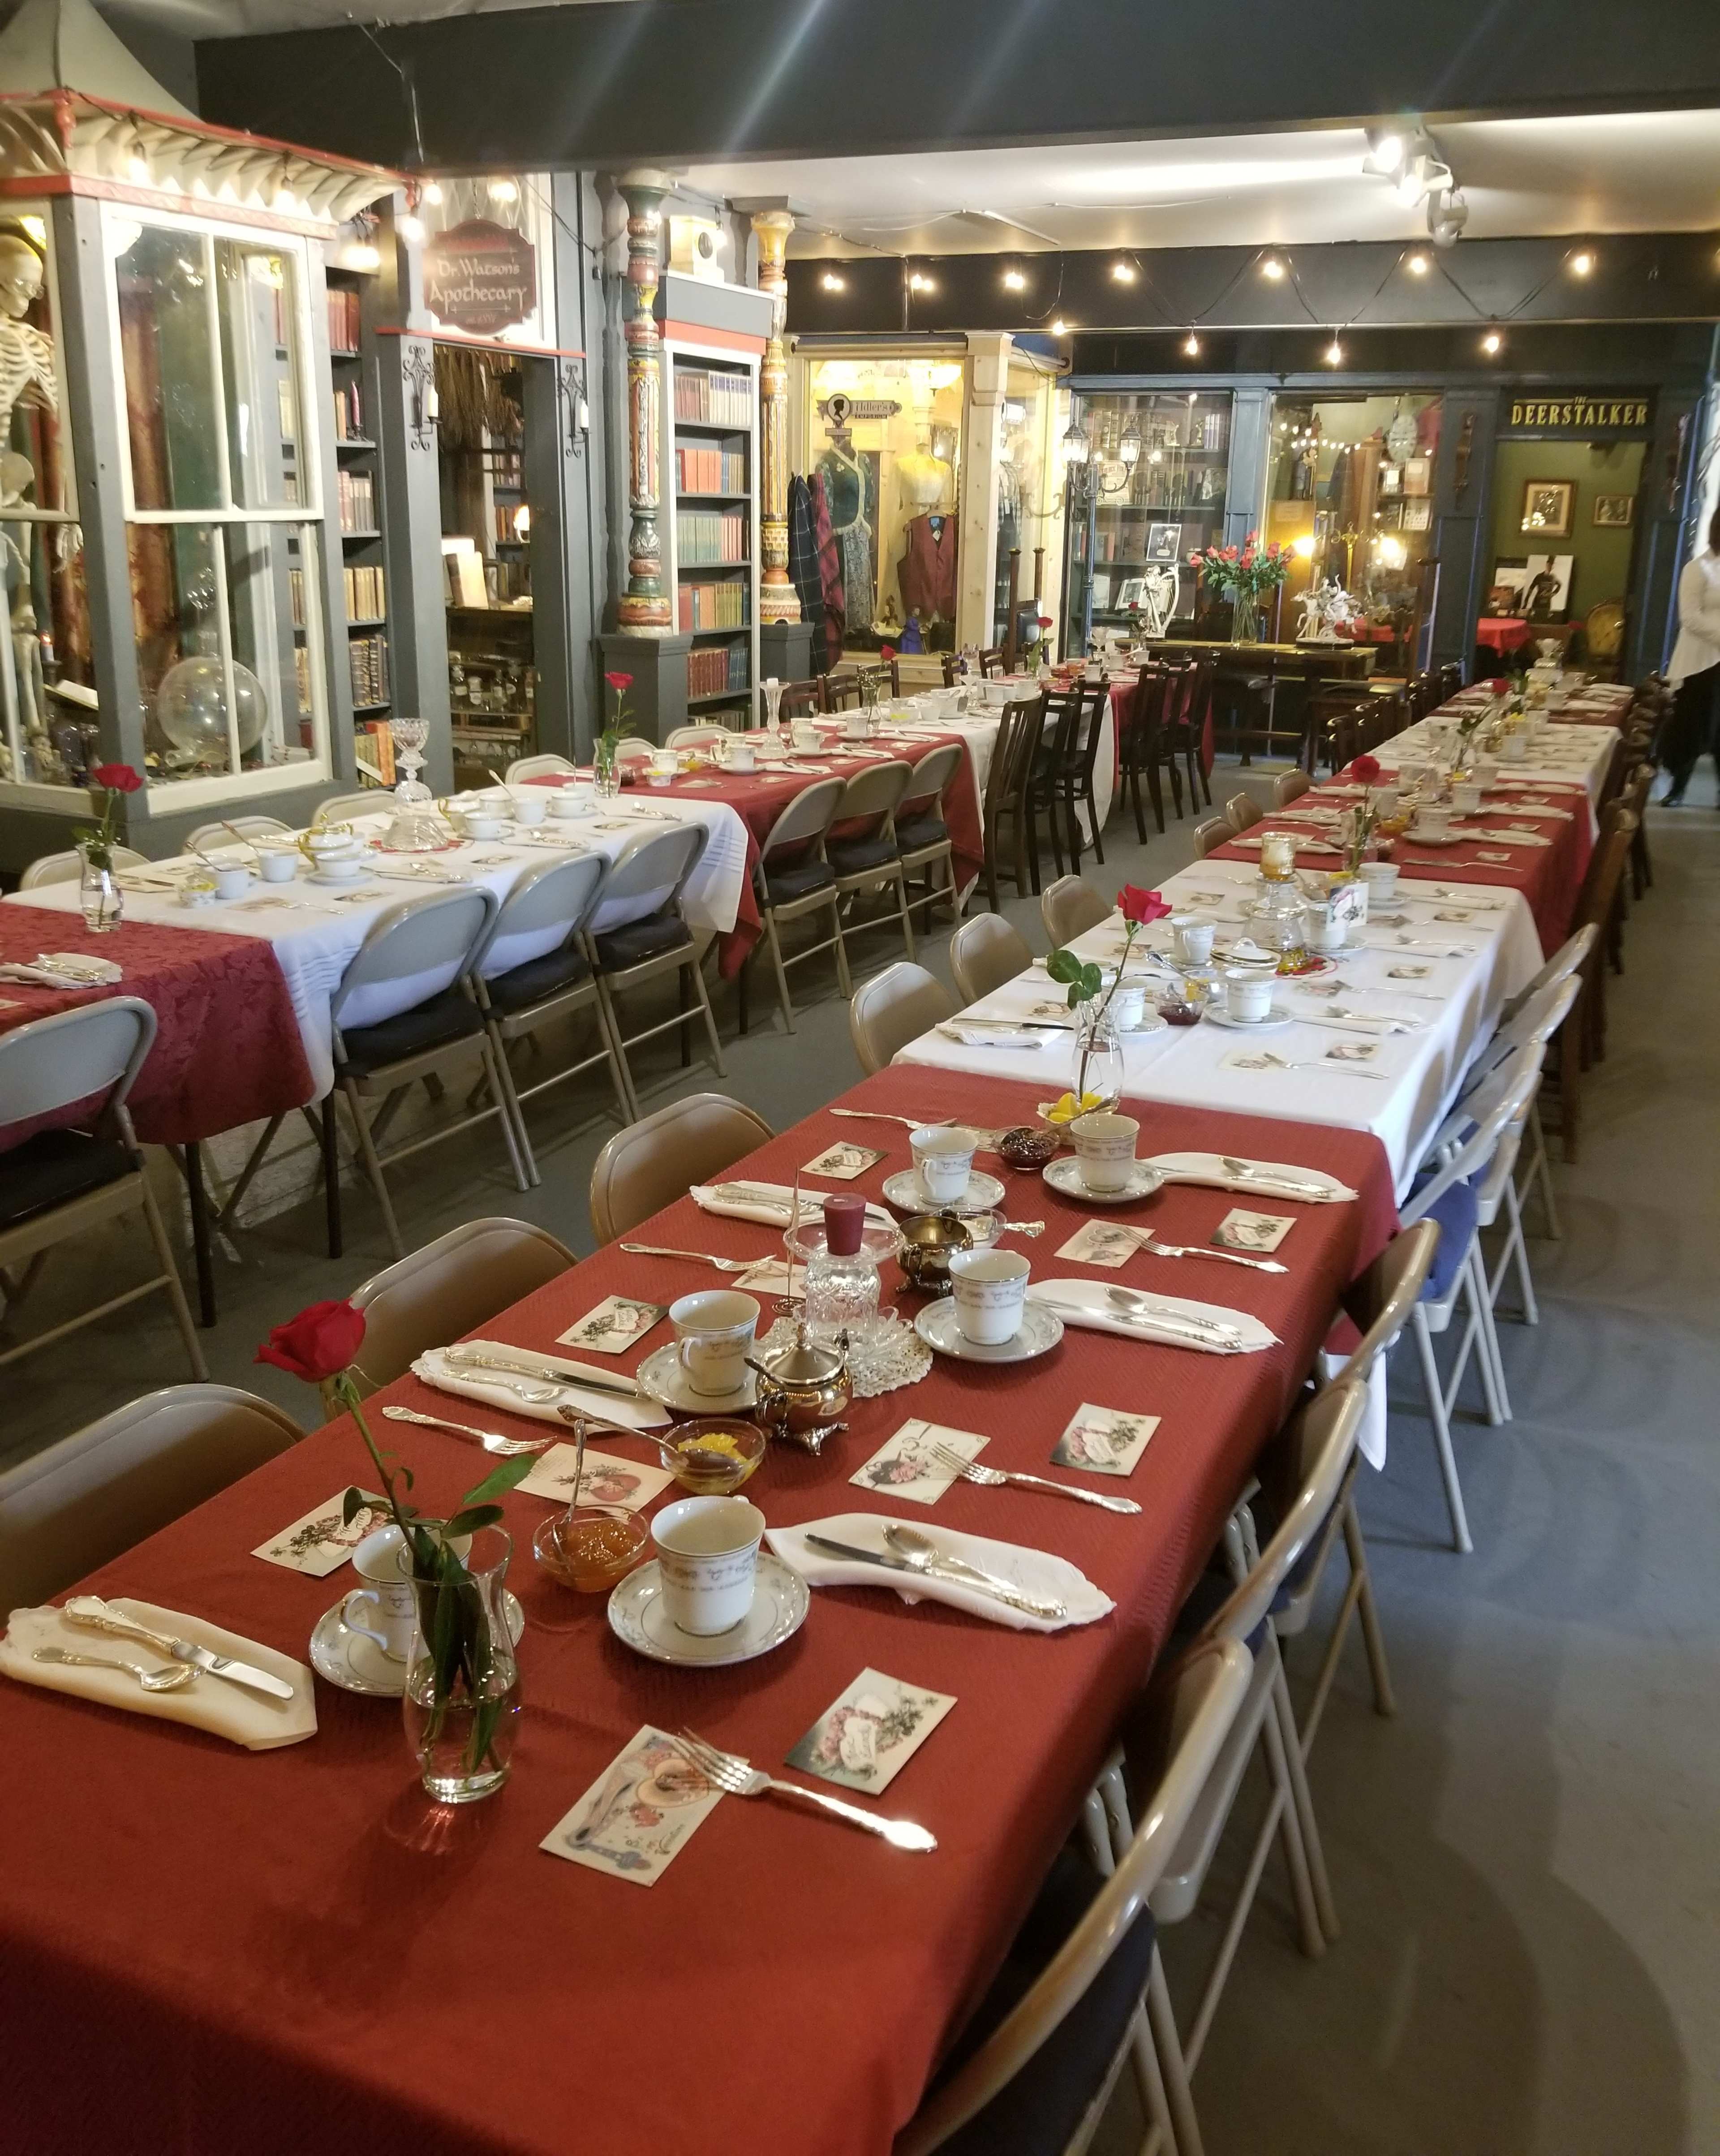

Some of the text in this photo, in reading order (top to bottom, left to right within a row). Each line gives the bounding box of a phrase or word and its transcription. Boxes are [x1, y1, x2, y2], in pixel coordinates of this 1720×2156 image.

[459, 257, 520, 277] Watson's
[430, 278, 528, 315] Apothecary
[1511, 405, 1648, 425] DEERSTALKER
